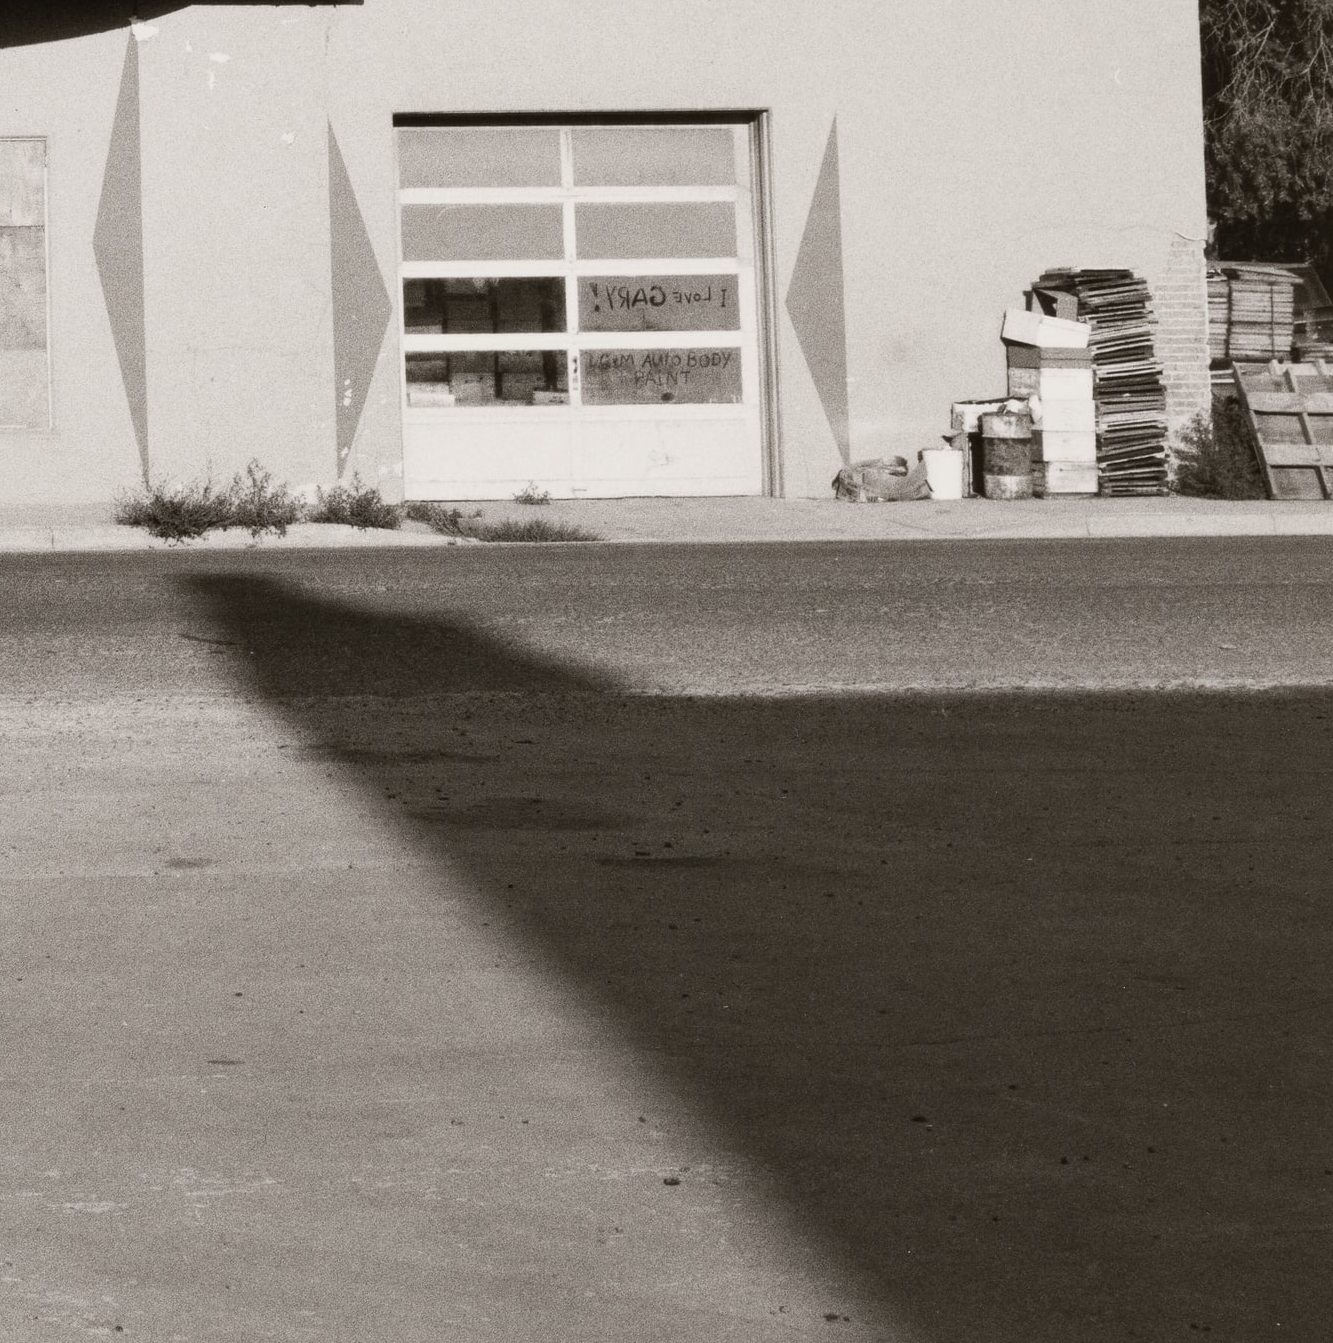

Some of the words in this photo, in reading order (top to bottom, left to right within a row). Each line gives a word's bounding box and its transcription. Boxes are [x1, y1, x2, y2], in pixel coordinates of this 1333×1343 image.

[641, 352, 682, 368] AUTO
[686, 351, 731, 369] BODY
[634, 370, 691, 388] PAINT
